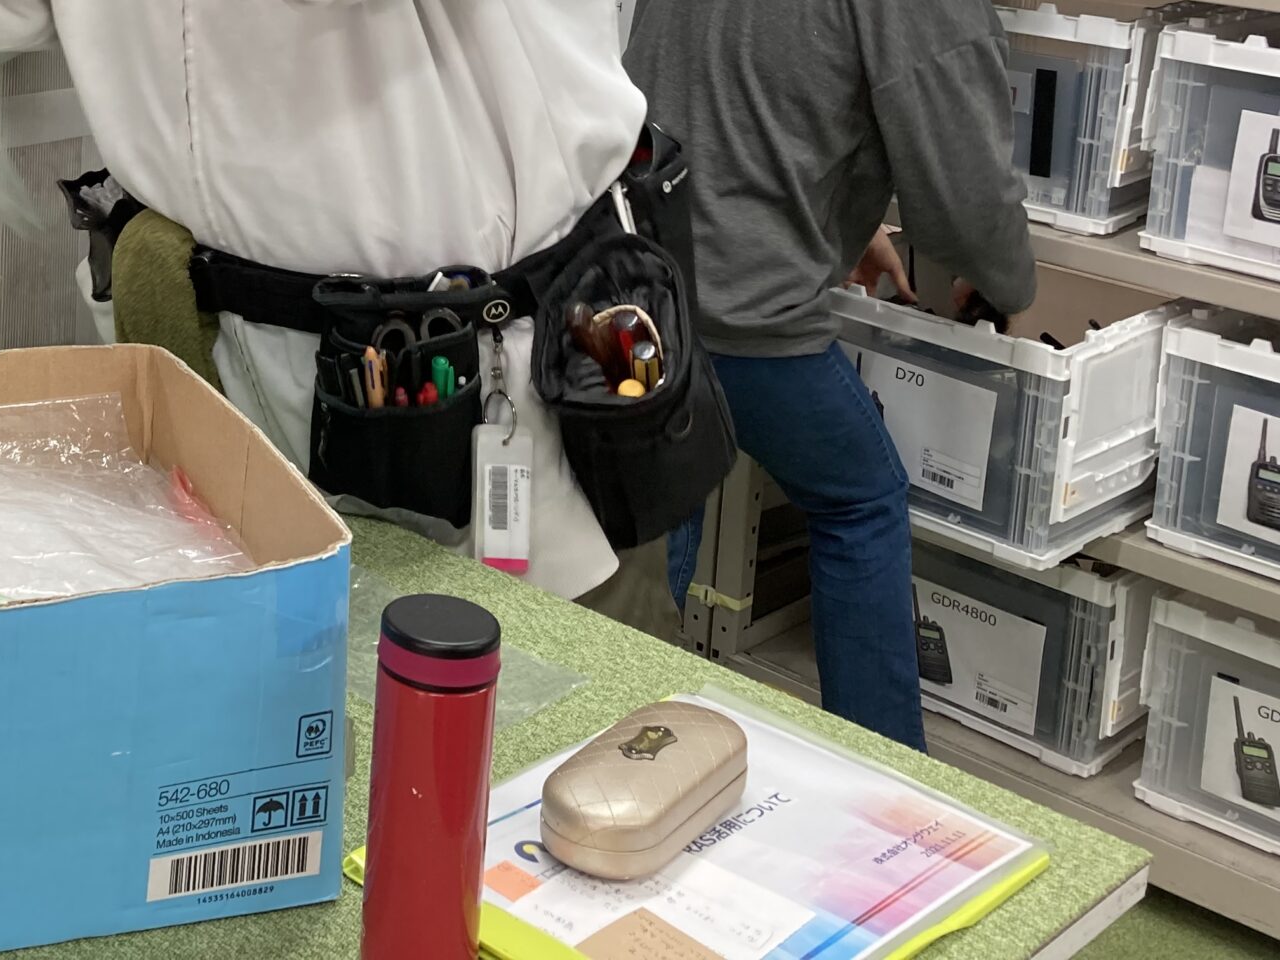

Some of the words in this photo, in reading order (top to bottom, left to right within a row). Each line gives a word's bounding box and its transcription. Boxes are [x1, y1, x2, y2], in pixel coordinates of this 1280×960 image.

[895, 366, 925, 387] D70
[931, 592, 997, 627] GDR4800
[303, 738, 325, 749] PEFC
[158, 779, 230, 807] 542-680
[195, 804, 229, 817] Sheets
[156, 837, 183, 850] Made
[185, 833, 194, 843] in
[195, 826, 241, 843] Indonesia
[157, 826, 171, 837] A4
[197, 885, 275, 905] 14535164008829
